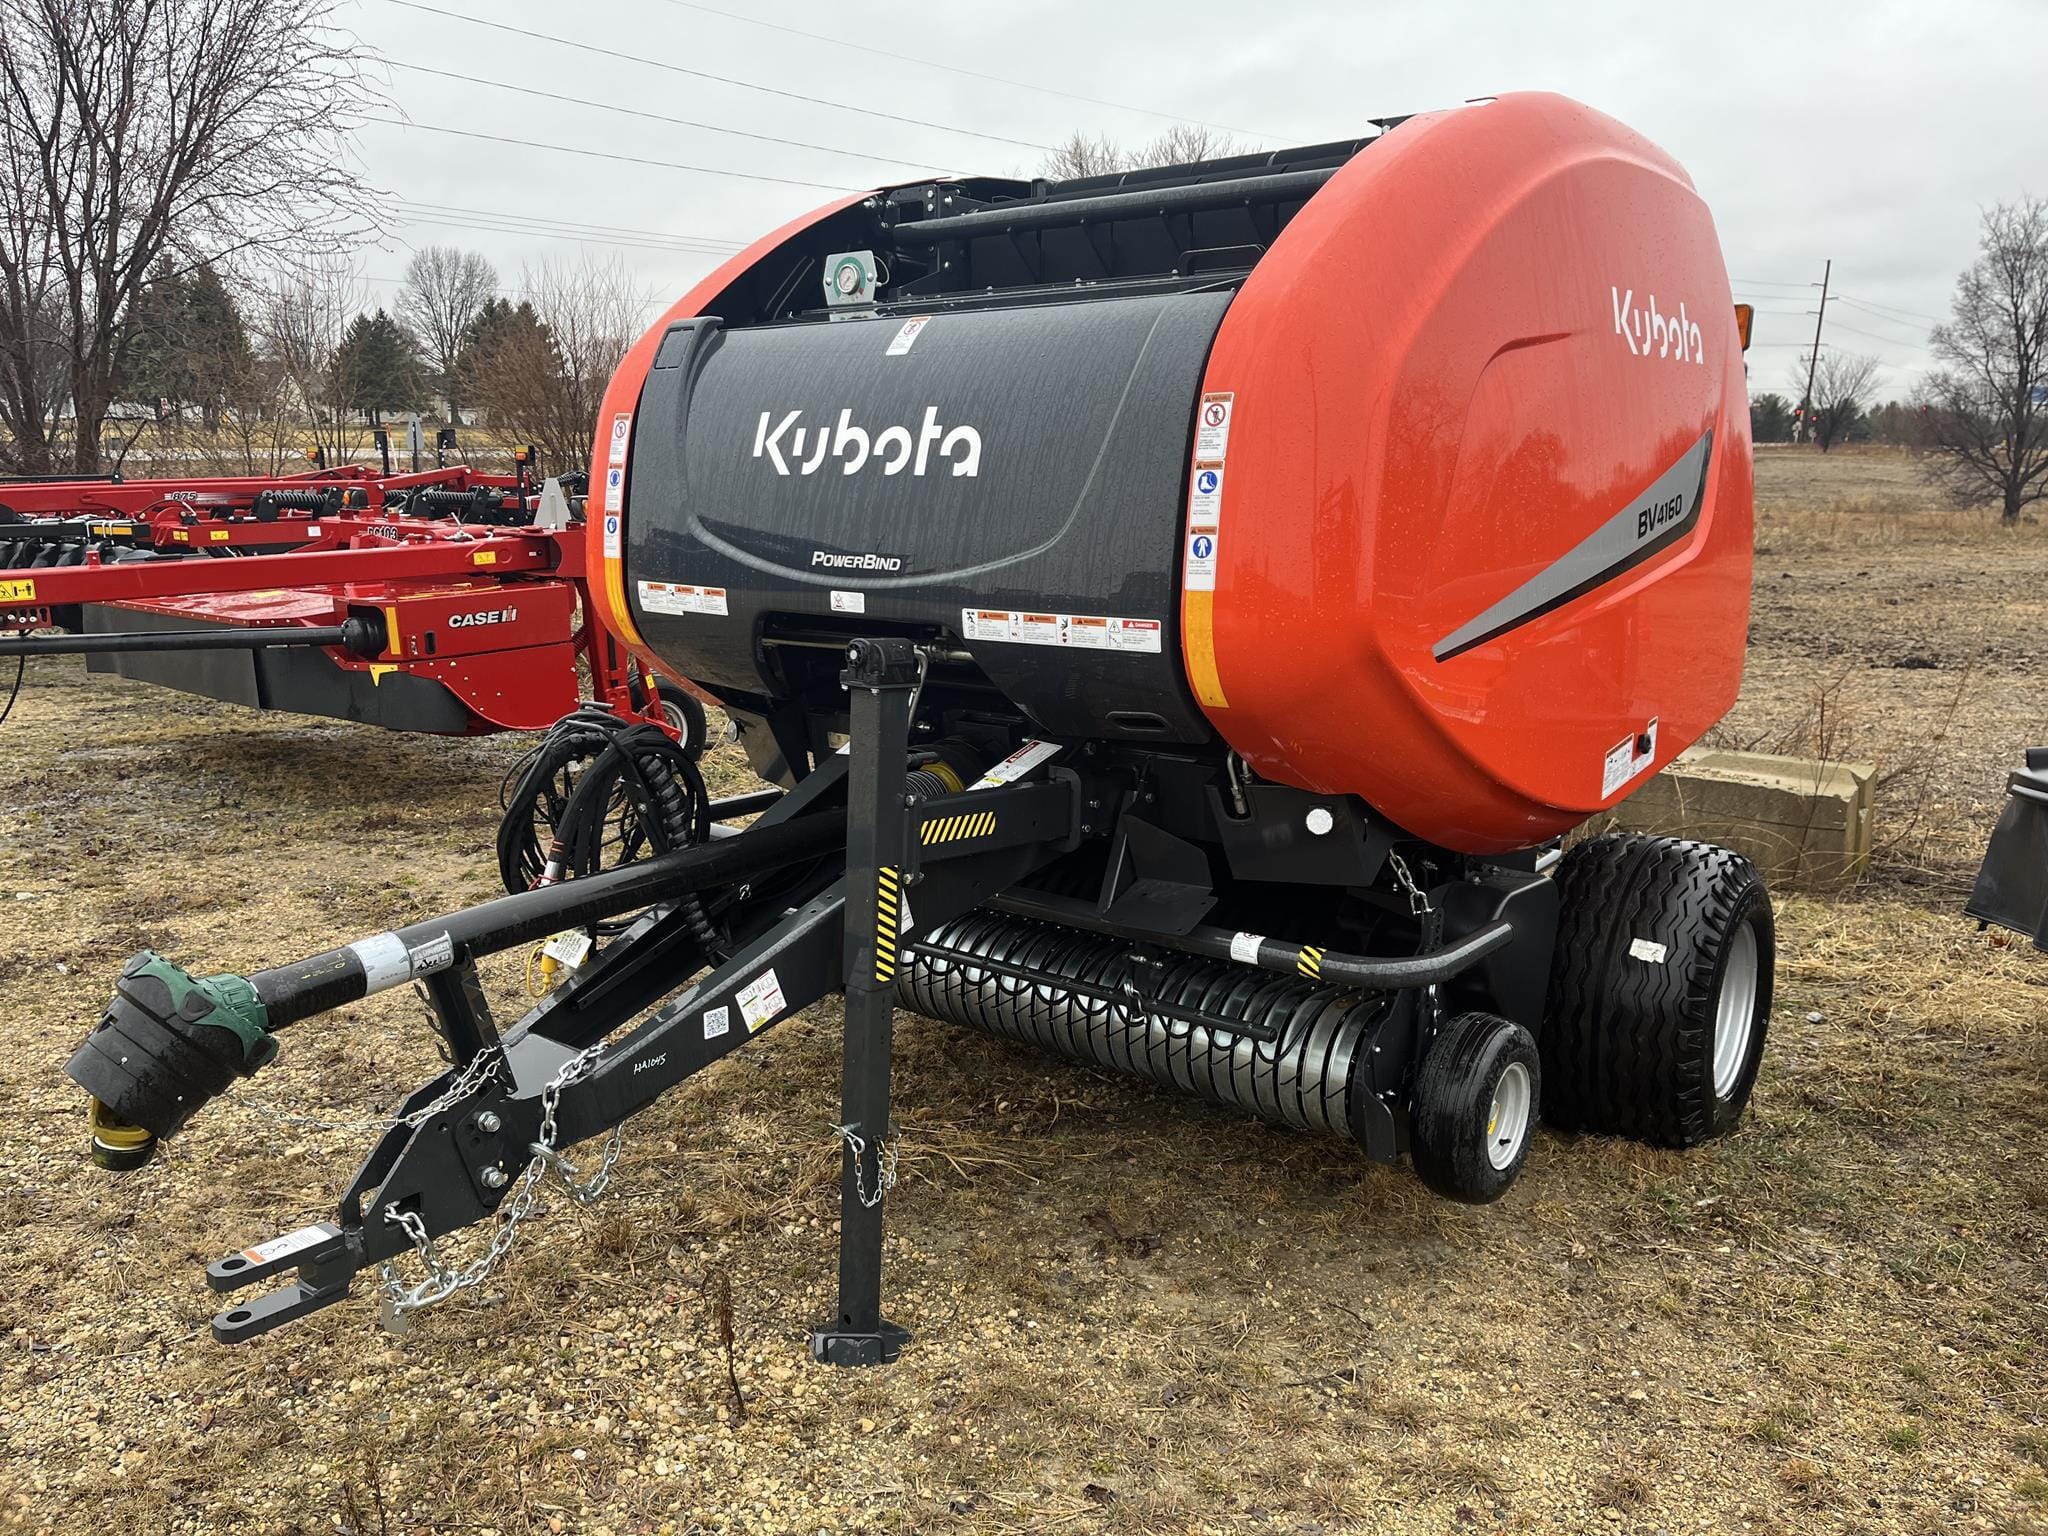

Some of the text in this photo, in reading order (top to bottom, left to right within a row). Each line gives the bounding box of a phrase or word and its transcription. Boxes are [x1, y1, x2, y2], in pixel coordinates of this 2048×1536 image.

[1611, 286, 1704, 365] Kubota
[752, 406, 982, 477] Kubota
[172, 491, 197, 501] 875
[1637, 494, 1682, 539] BV4160
[448, 611, 500, 628] CASE
